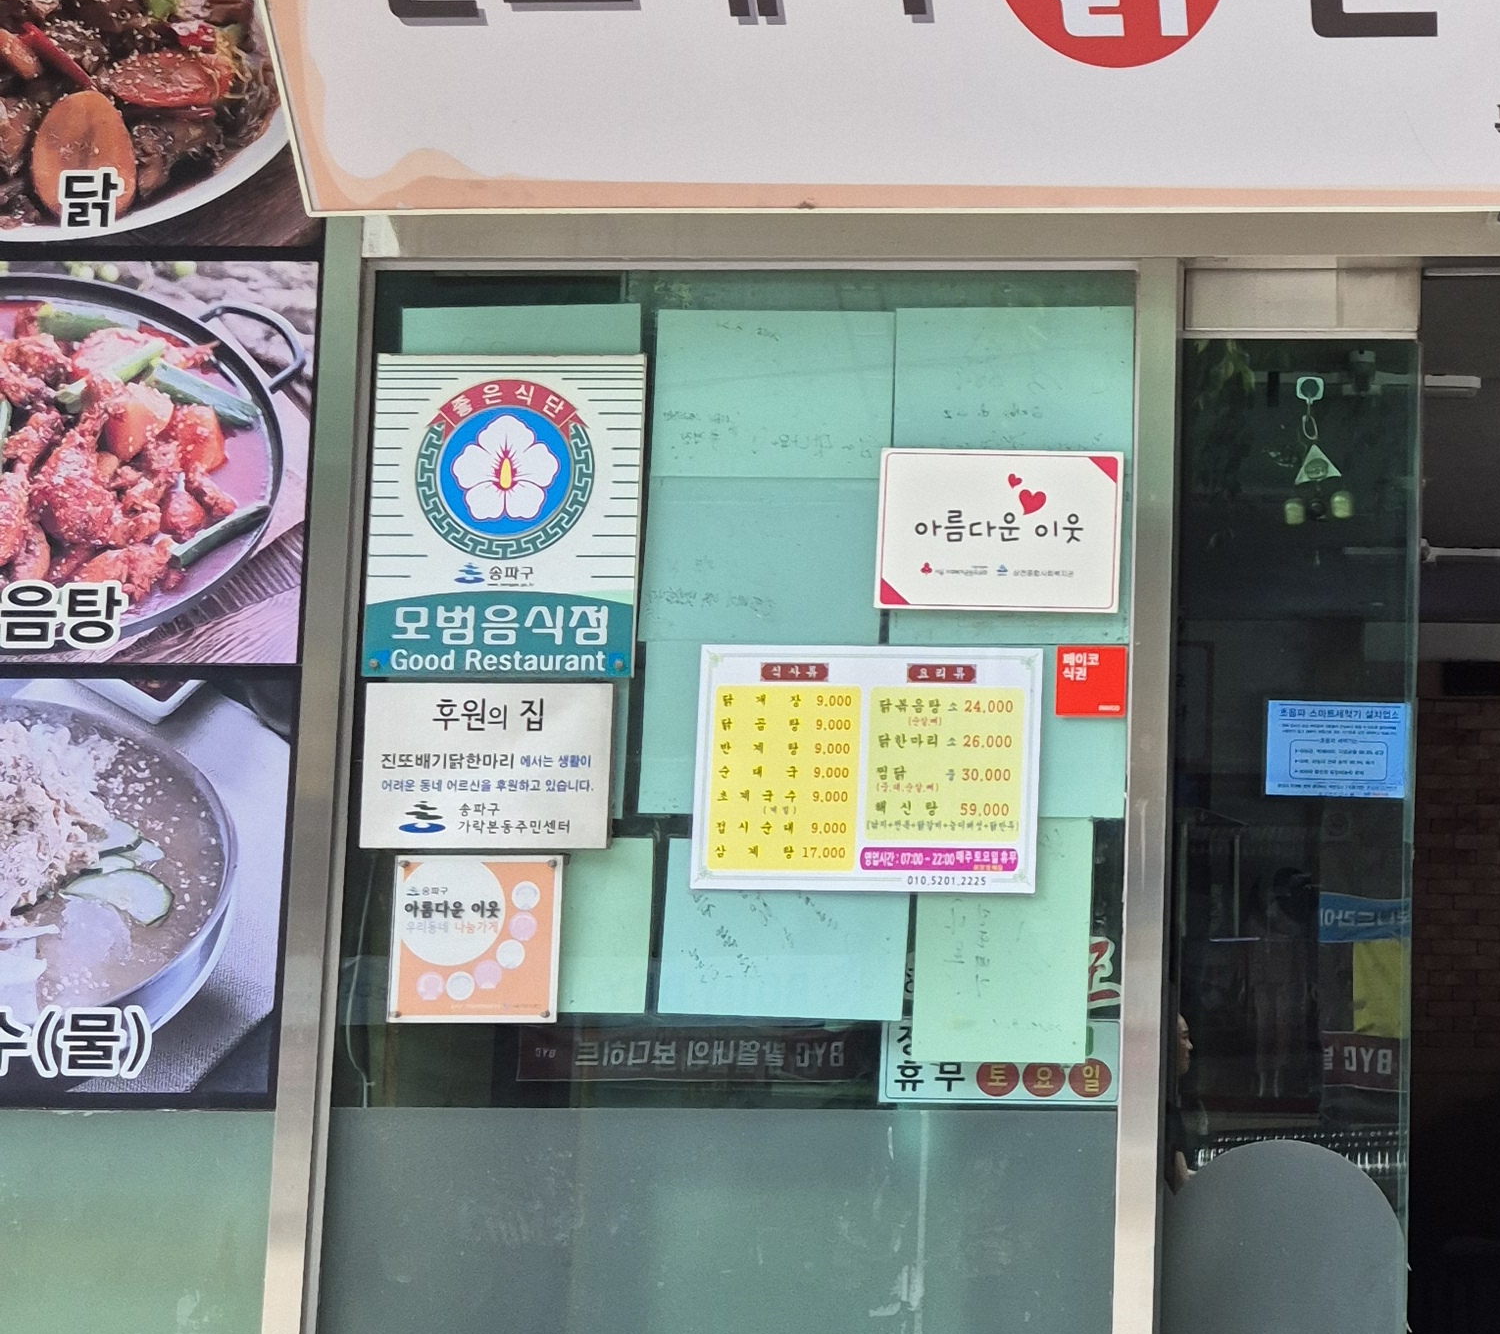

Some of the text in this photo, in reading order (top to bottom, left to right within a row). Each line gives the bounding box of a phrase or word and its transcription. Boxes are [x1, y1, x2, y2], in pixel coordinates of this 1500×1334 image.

[63, 170, 120, 229] 닭
[914, 509, 1084, 544] 아름다운 이웃
[488, 565, 534, 581] 송파구
[389, 604, 609, 646] 모범음식점
[389, 648, 607, 673] Good Restaurant
[1062, 652, 1100, 666] 페이코
[1062, 666, 1088, 681] 식권
[431, 697, 546, 732] 후원의 집
[877, 733, 939, 749] 닭한마리
[380, 752, 515, 770] 진또배기닭한마리
[519, 754, 554, 768] 에서는
[381, 778, 594, 793] 어려운 동네 어르신을 후원하고 있습니다.
[458, 802, 501, 817] 송파구
[457, 818, 572, 835] 가락본동주민센터
[404, 899, 501, 919] 아름다운 이웃
